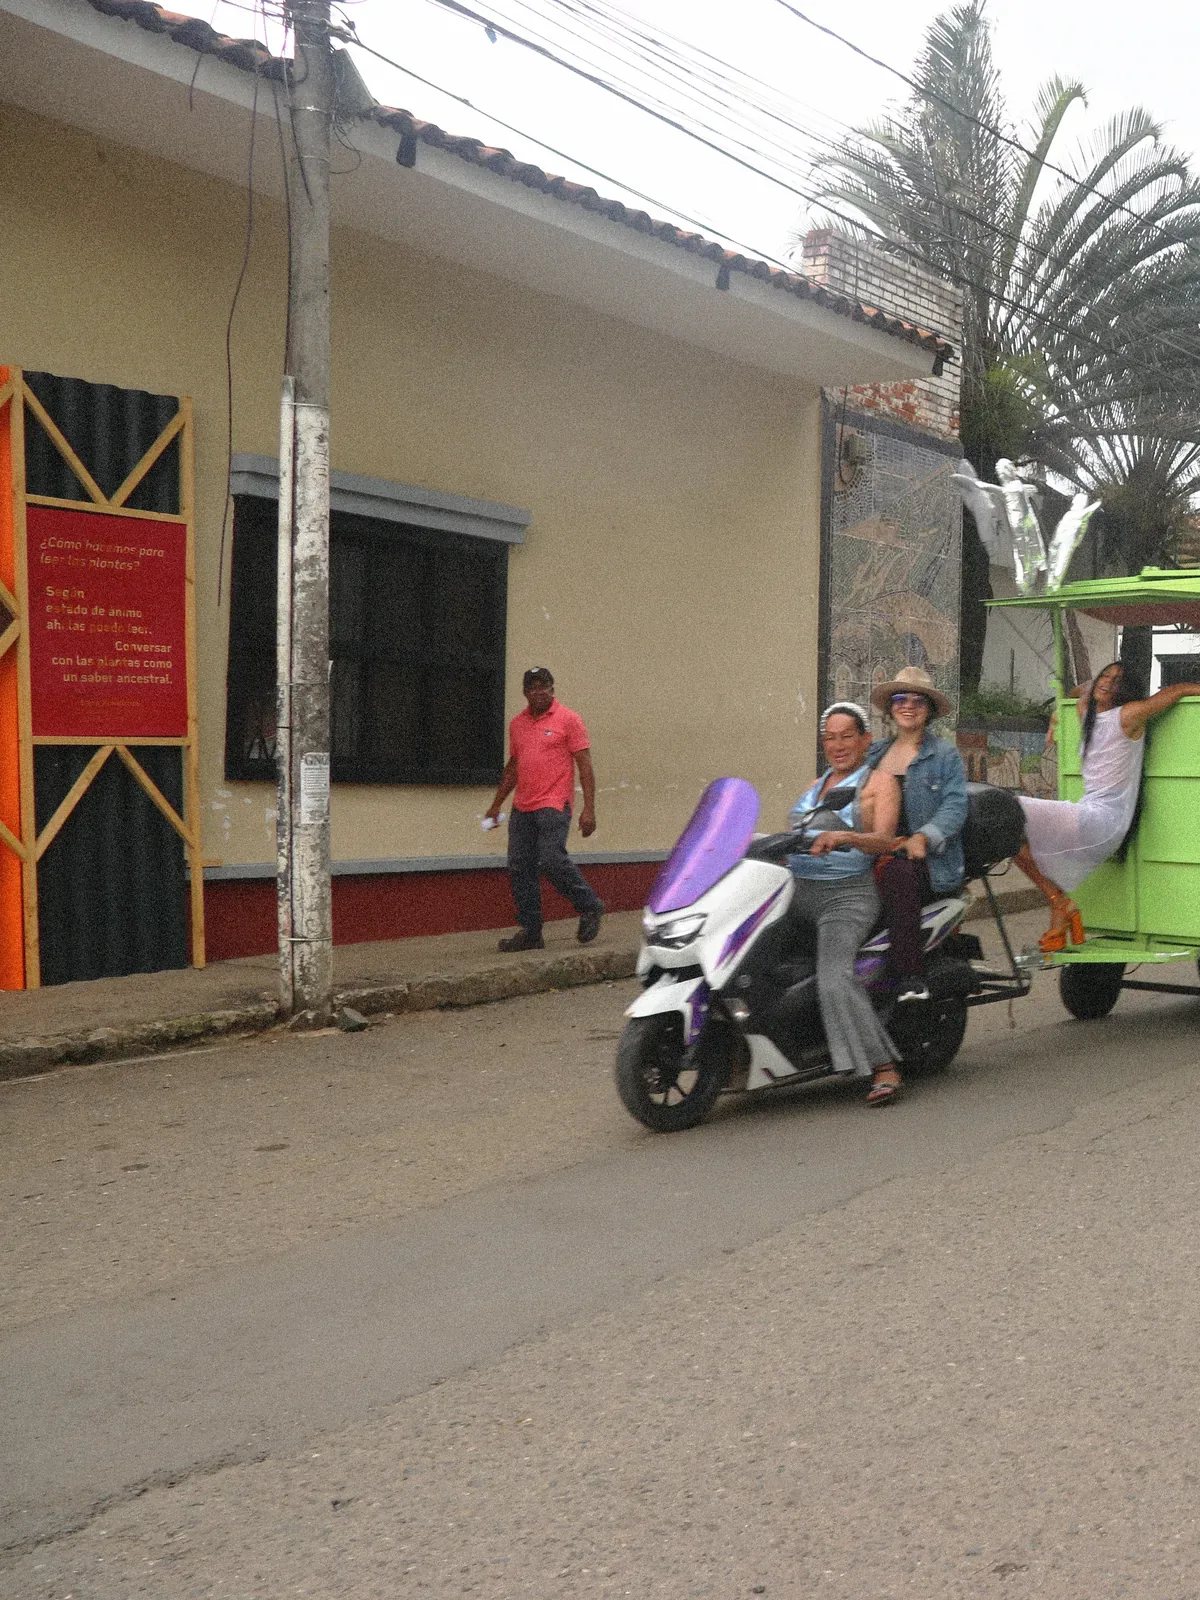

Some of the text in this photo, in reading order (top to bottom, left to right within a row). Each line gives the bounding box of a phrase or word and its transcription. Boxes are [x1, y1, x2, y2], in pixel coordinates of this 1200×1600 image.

[139, 547, 165, 558] para
[91, 605, 105, 616] de
[115, 641, 172, 653] Conversar
[52, 656, 73, 666] con
[76, 655, 93, 666] las
[143, 659, 173, 669] como
[63, 672, 173, 684] un saber ancestral.
